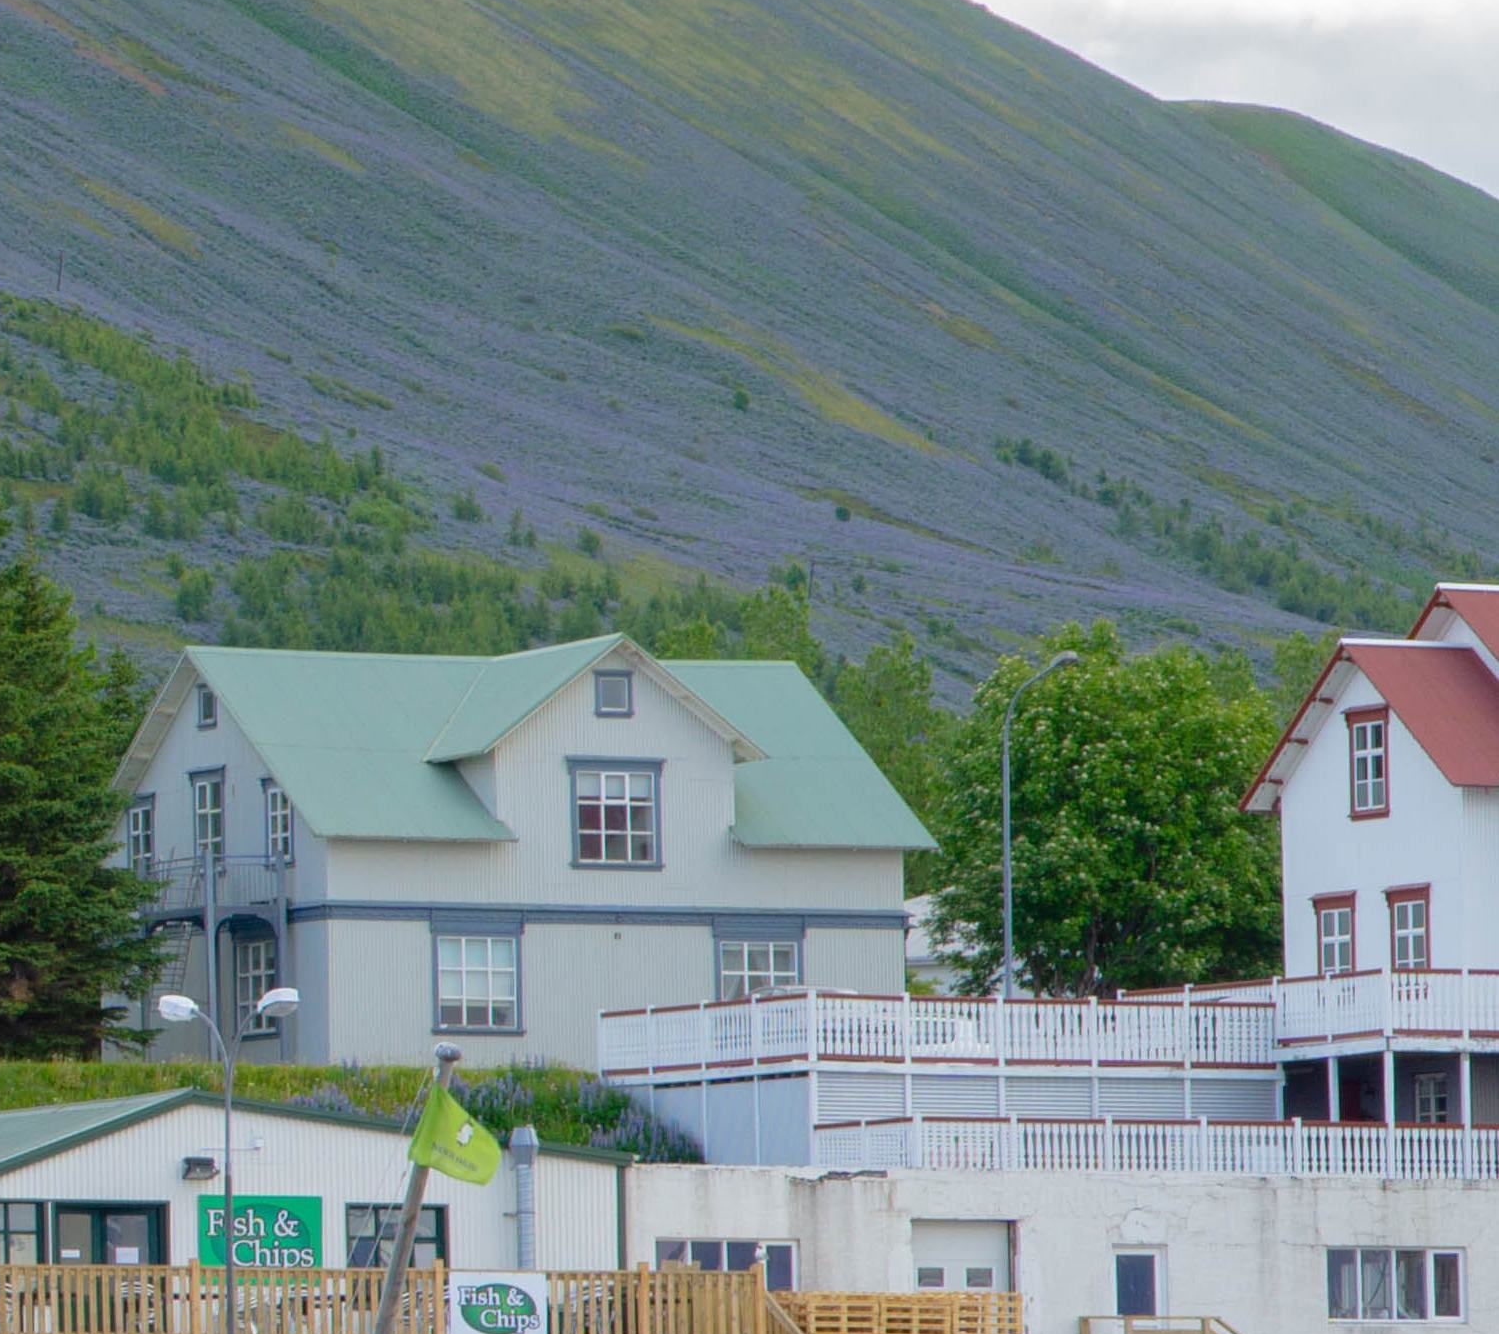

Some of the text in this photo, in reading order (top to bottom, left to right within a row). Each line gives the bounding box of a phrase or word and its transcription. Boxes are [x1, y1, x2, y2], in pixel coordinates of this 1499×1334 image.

[207, 1208, 300, 1237] Fsh &
[232, 1239, 315, 1268] Chips
[458, 1286, 525, 1307] Fish &
[480, 1308, 540, 1334] Chips
